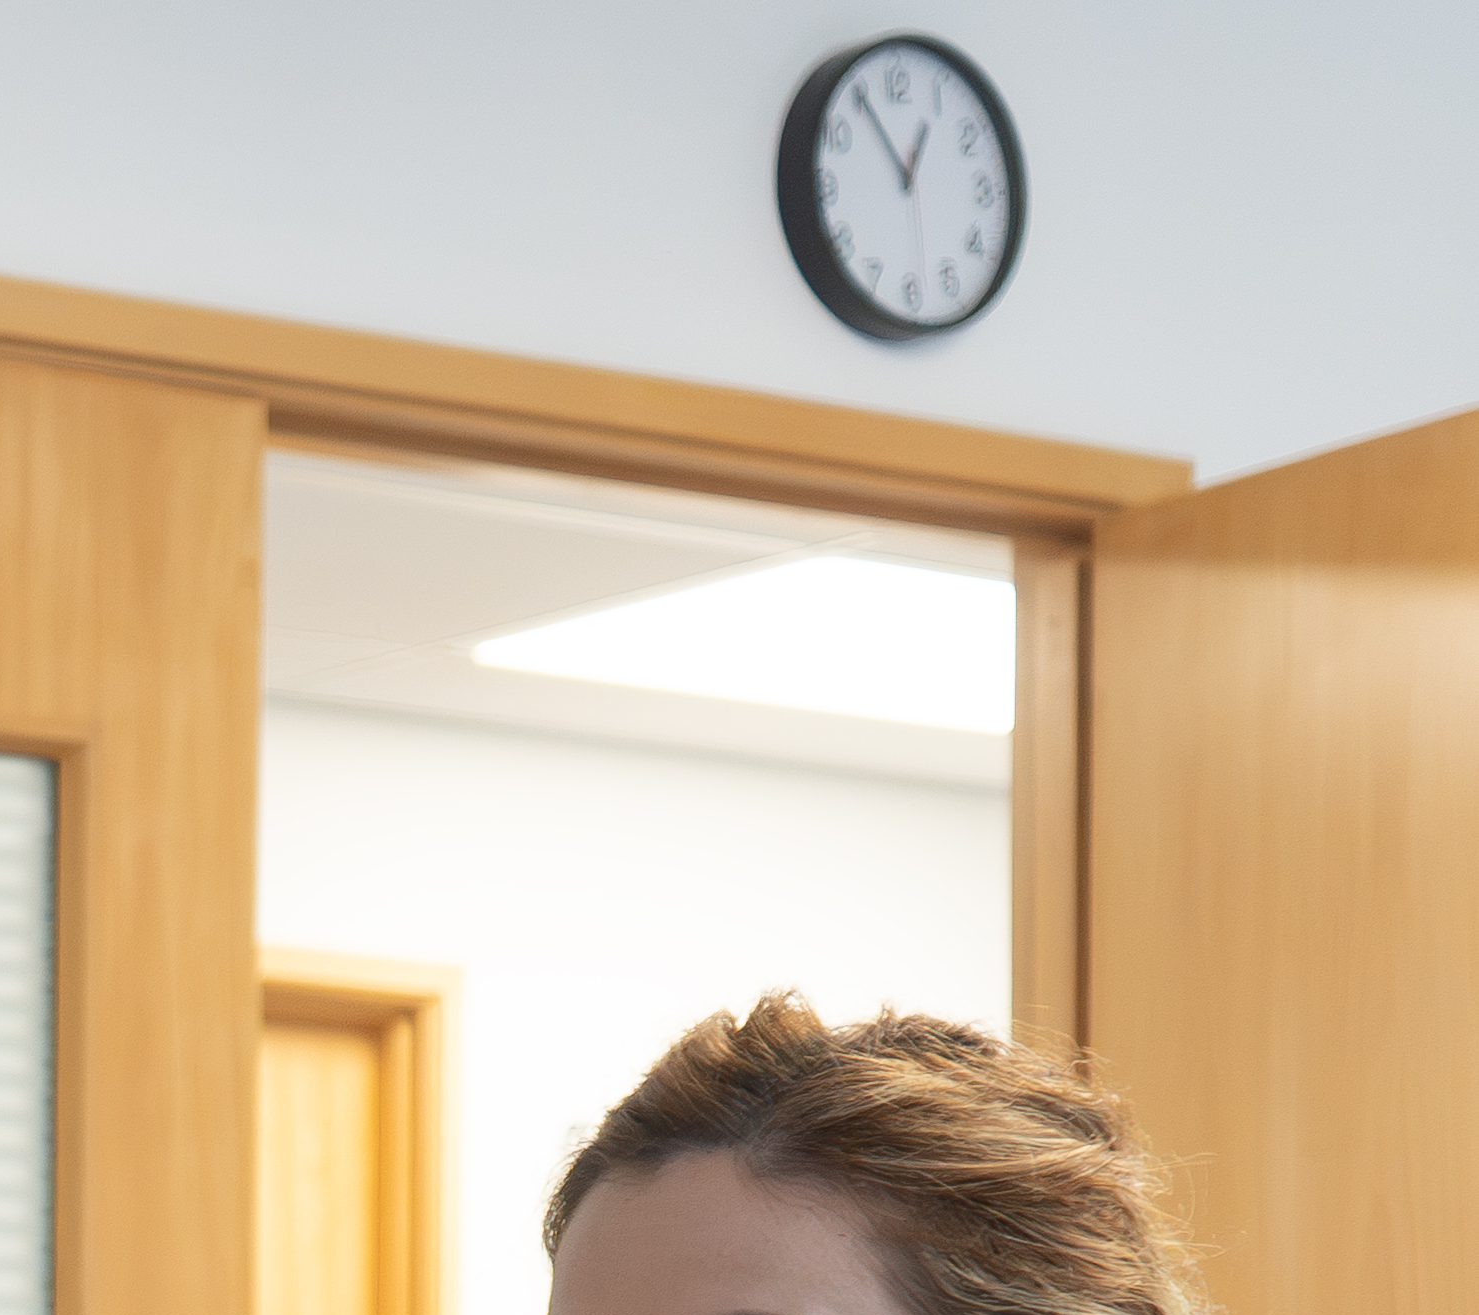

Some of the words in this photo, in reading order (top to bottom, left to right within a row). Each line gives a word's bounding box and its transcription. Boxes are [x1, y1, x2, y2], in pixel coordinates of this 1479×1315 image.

[884, 68, 913, 104] 12
[933, 79, 943, 117] 1
[827, 114, 853, 155] 10
[958, 114, 978, 155] 2
[973, 169, 994, 209] 3
[963, 220, 984, 256] 4
[864, 256, 884, 293] 7
[901, 271, 923, 313] 6
[939, 256, 960, 298] 5
